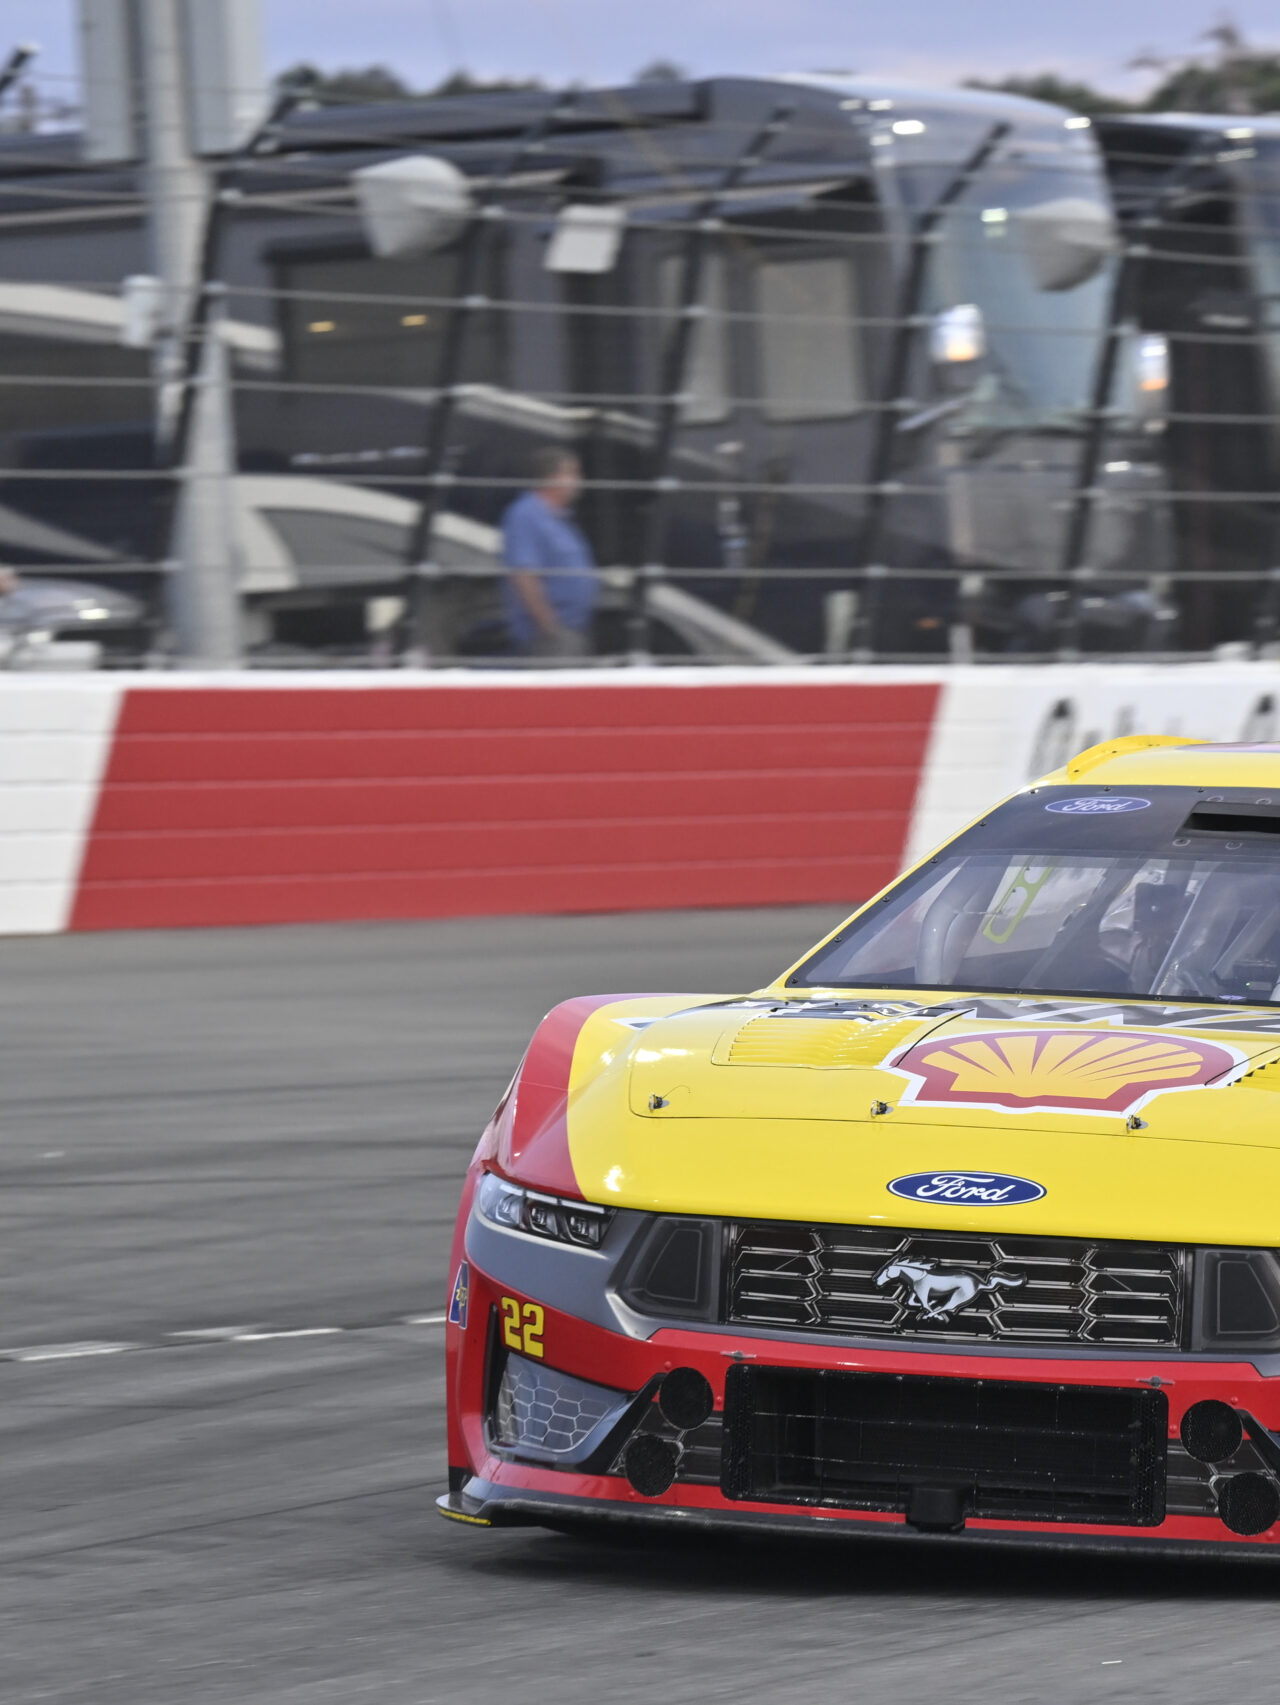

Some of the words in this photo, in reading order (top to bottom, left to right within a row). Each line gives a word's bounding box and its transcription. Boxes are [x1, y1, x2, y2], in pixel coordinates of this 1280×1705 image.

[1060, 797, 1134, 812] Ford
[915, 1174, 1017, 1201] Ford
[501, 1296, 545, 1358] 22
